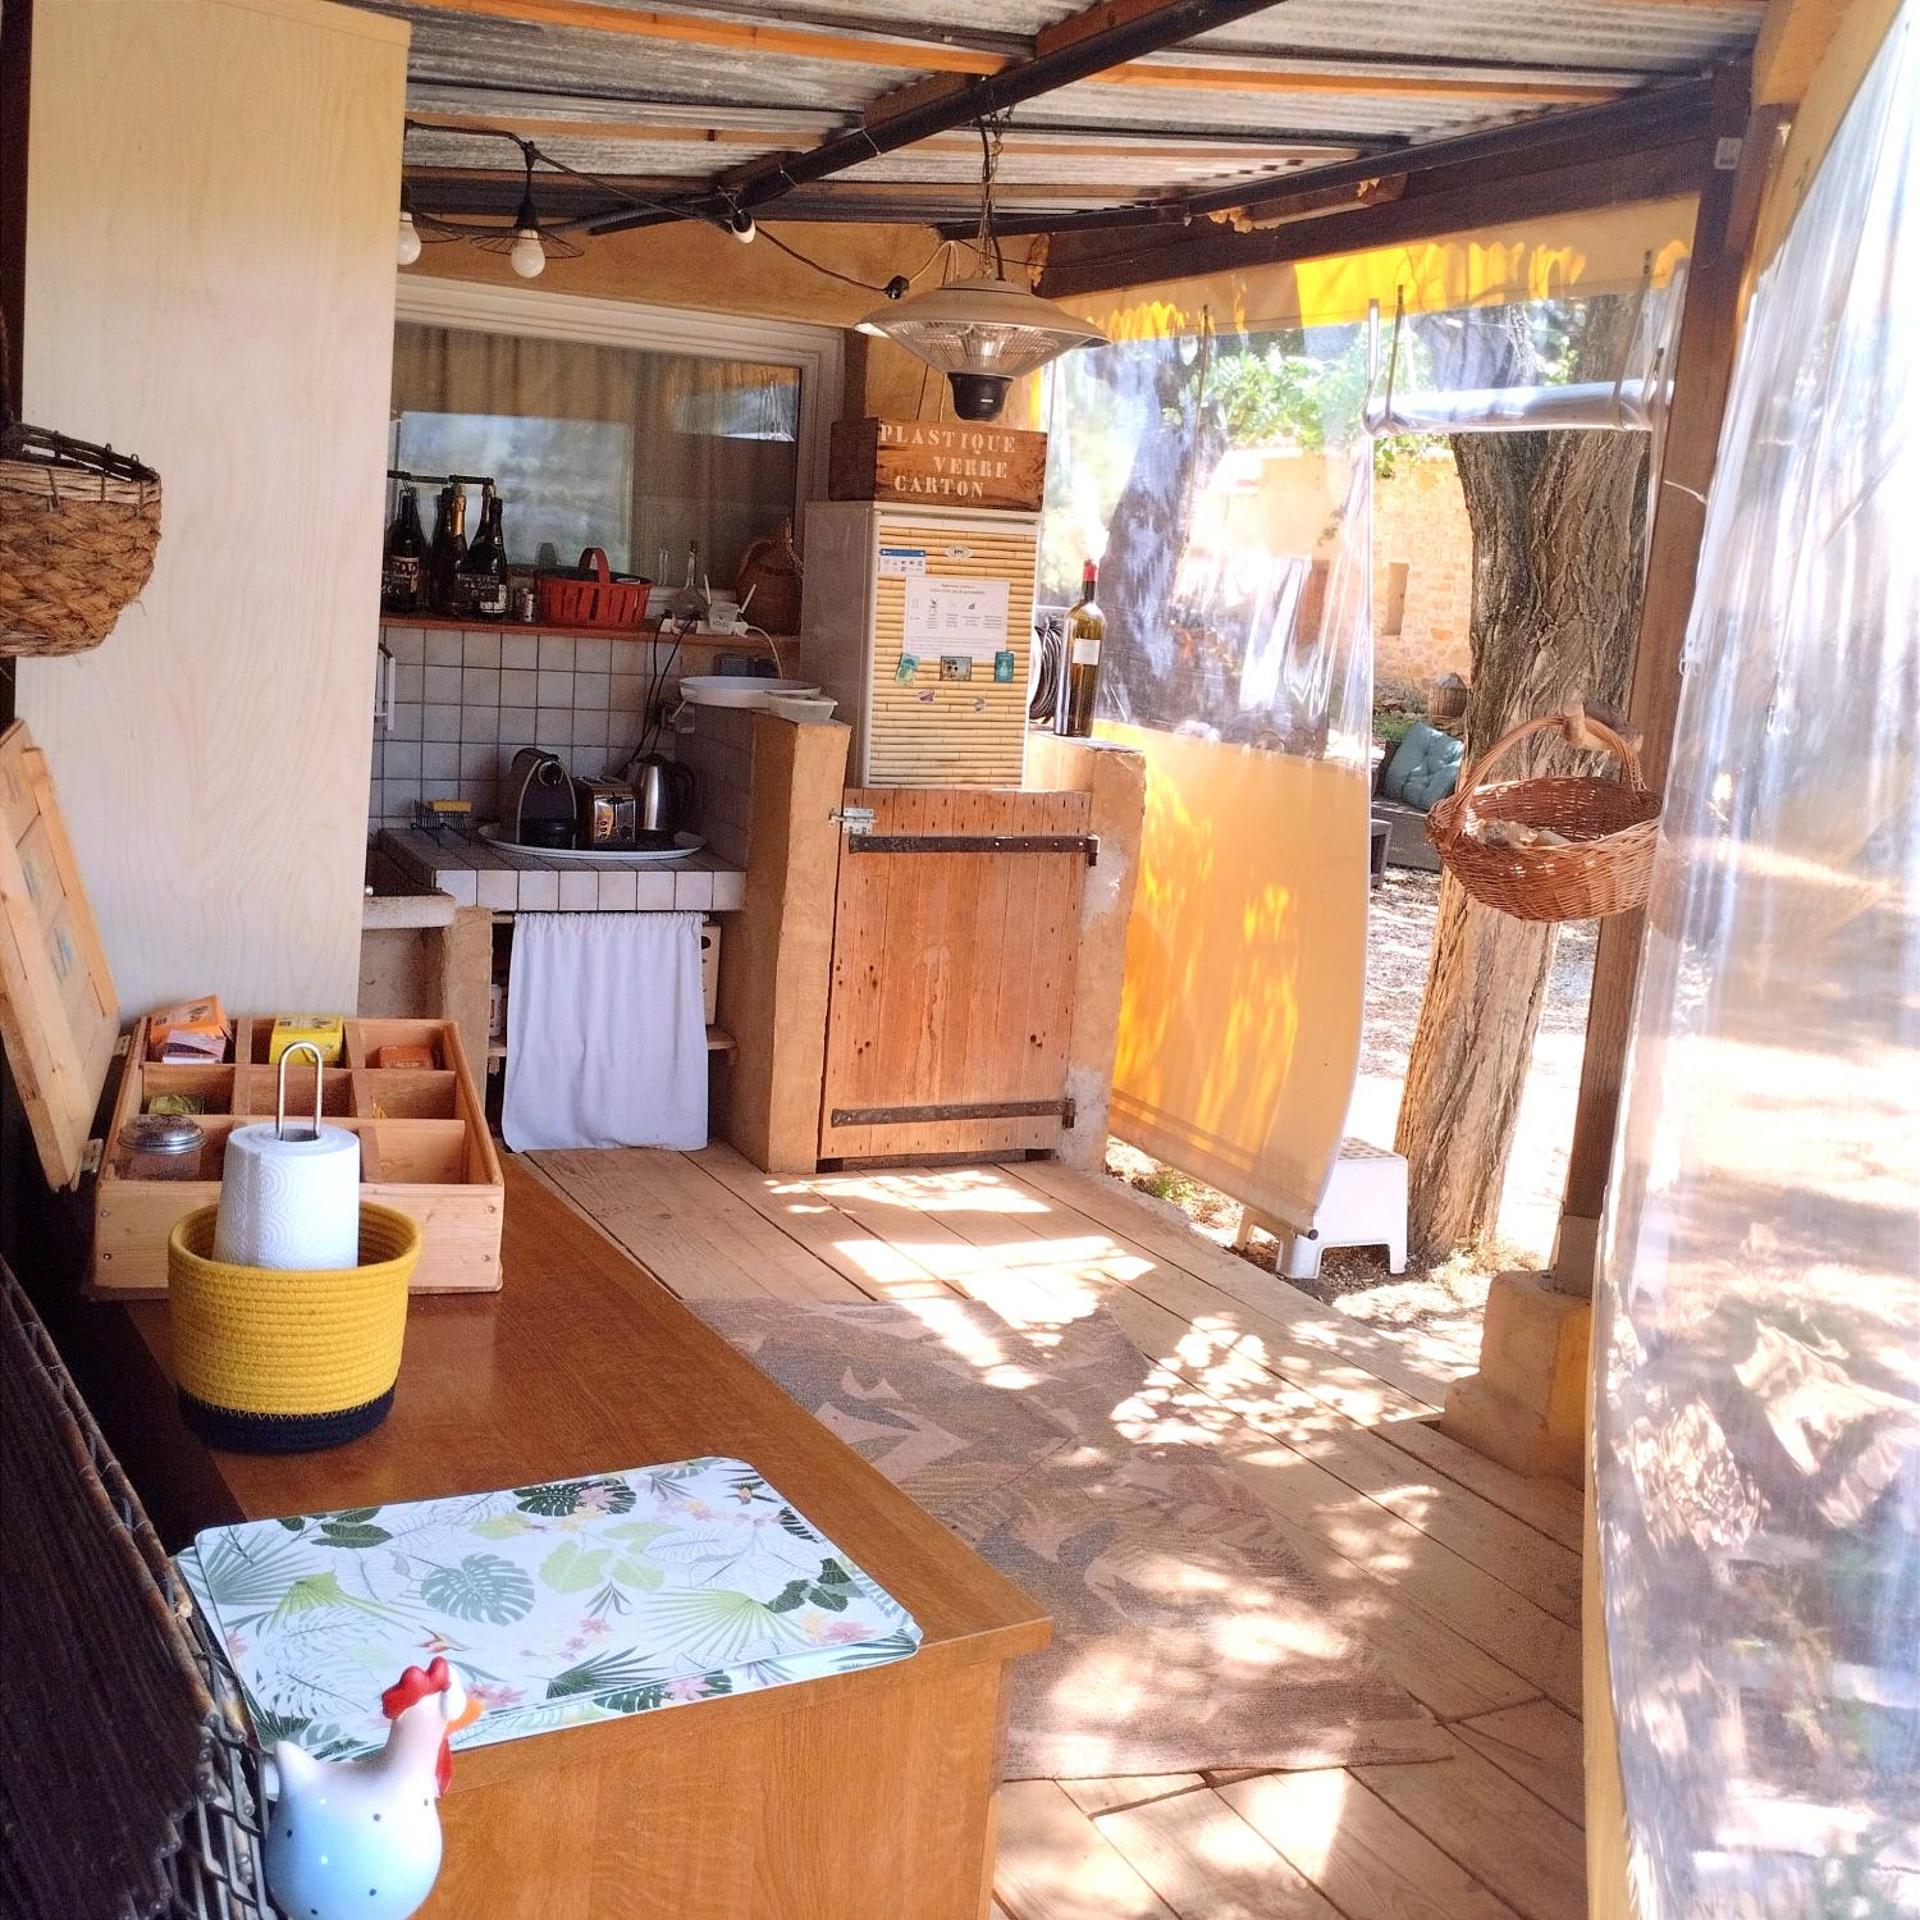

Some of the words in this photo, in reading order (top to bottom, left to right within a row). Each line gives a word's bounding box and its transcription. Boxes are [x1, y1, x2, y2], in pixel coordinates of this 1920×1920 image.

[880, 424, 1015, 454] PLASTIQUE
[933, 456, 1007, 478] VERRE
[894, 475, 985, 498] CARTON
